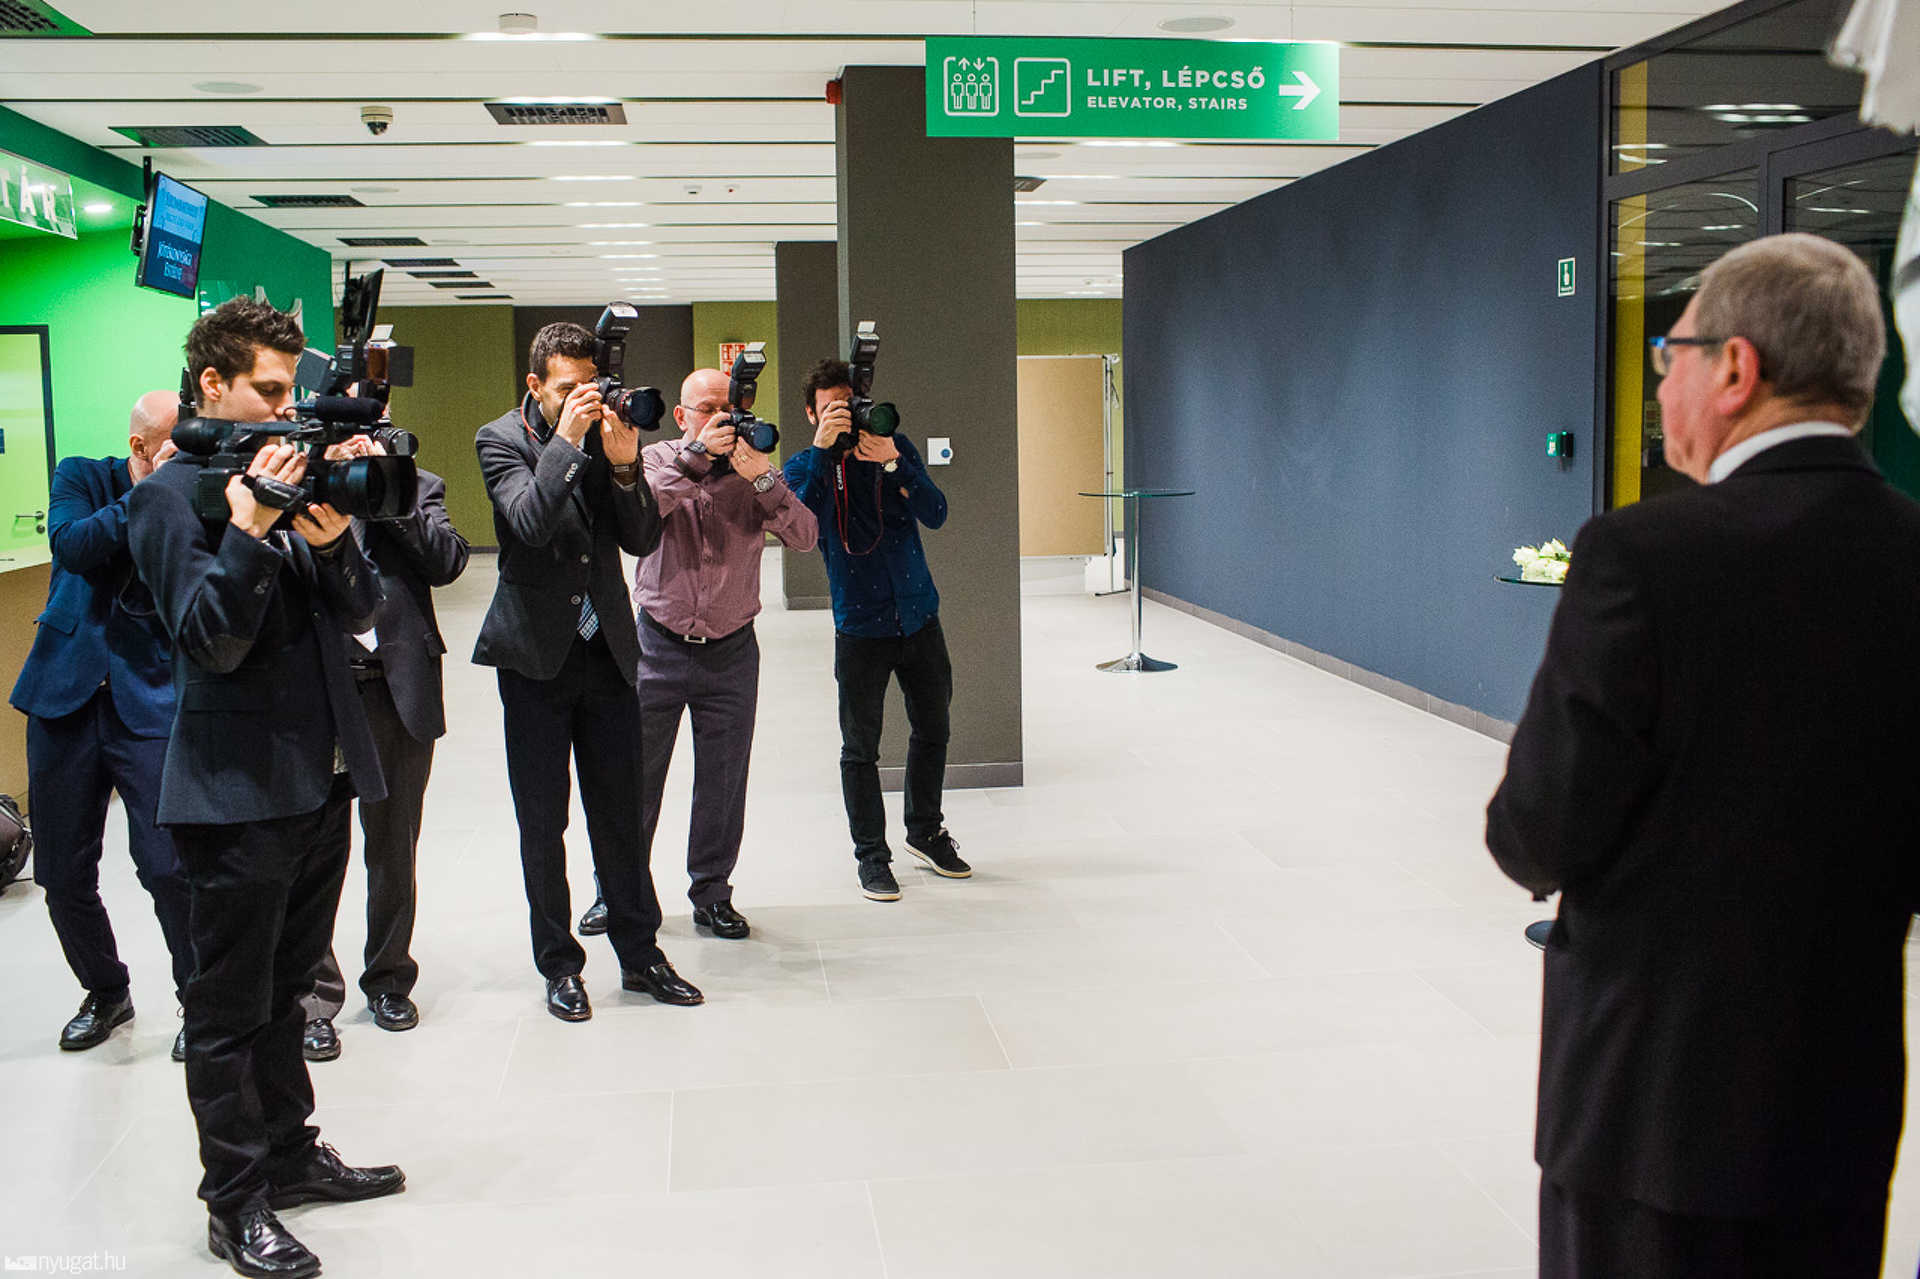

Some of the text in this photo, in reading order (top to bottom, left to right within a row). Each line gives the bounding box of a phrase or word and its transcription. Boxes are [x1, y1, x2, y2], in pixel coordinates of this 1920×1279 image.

[1087, 66, 1265, 90] LIFT, LÉPCSŐ
[1087, 97, 1248, 110] ELEVATOR, STAIRS
